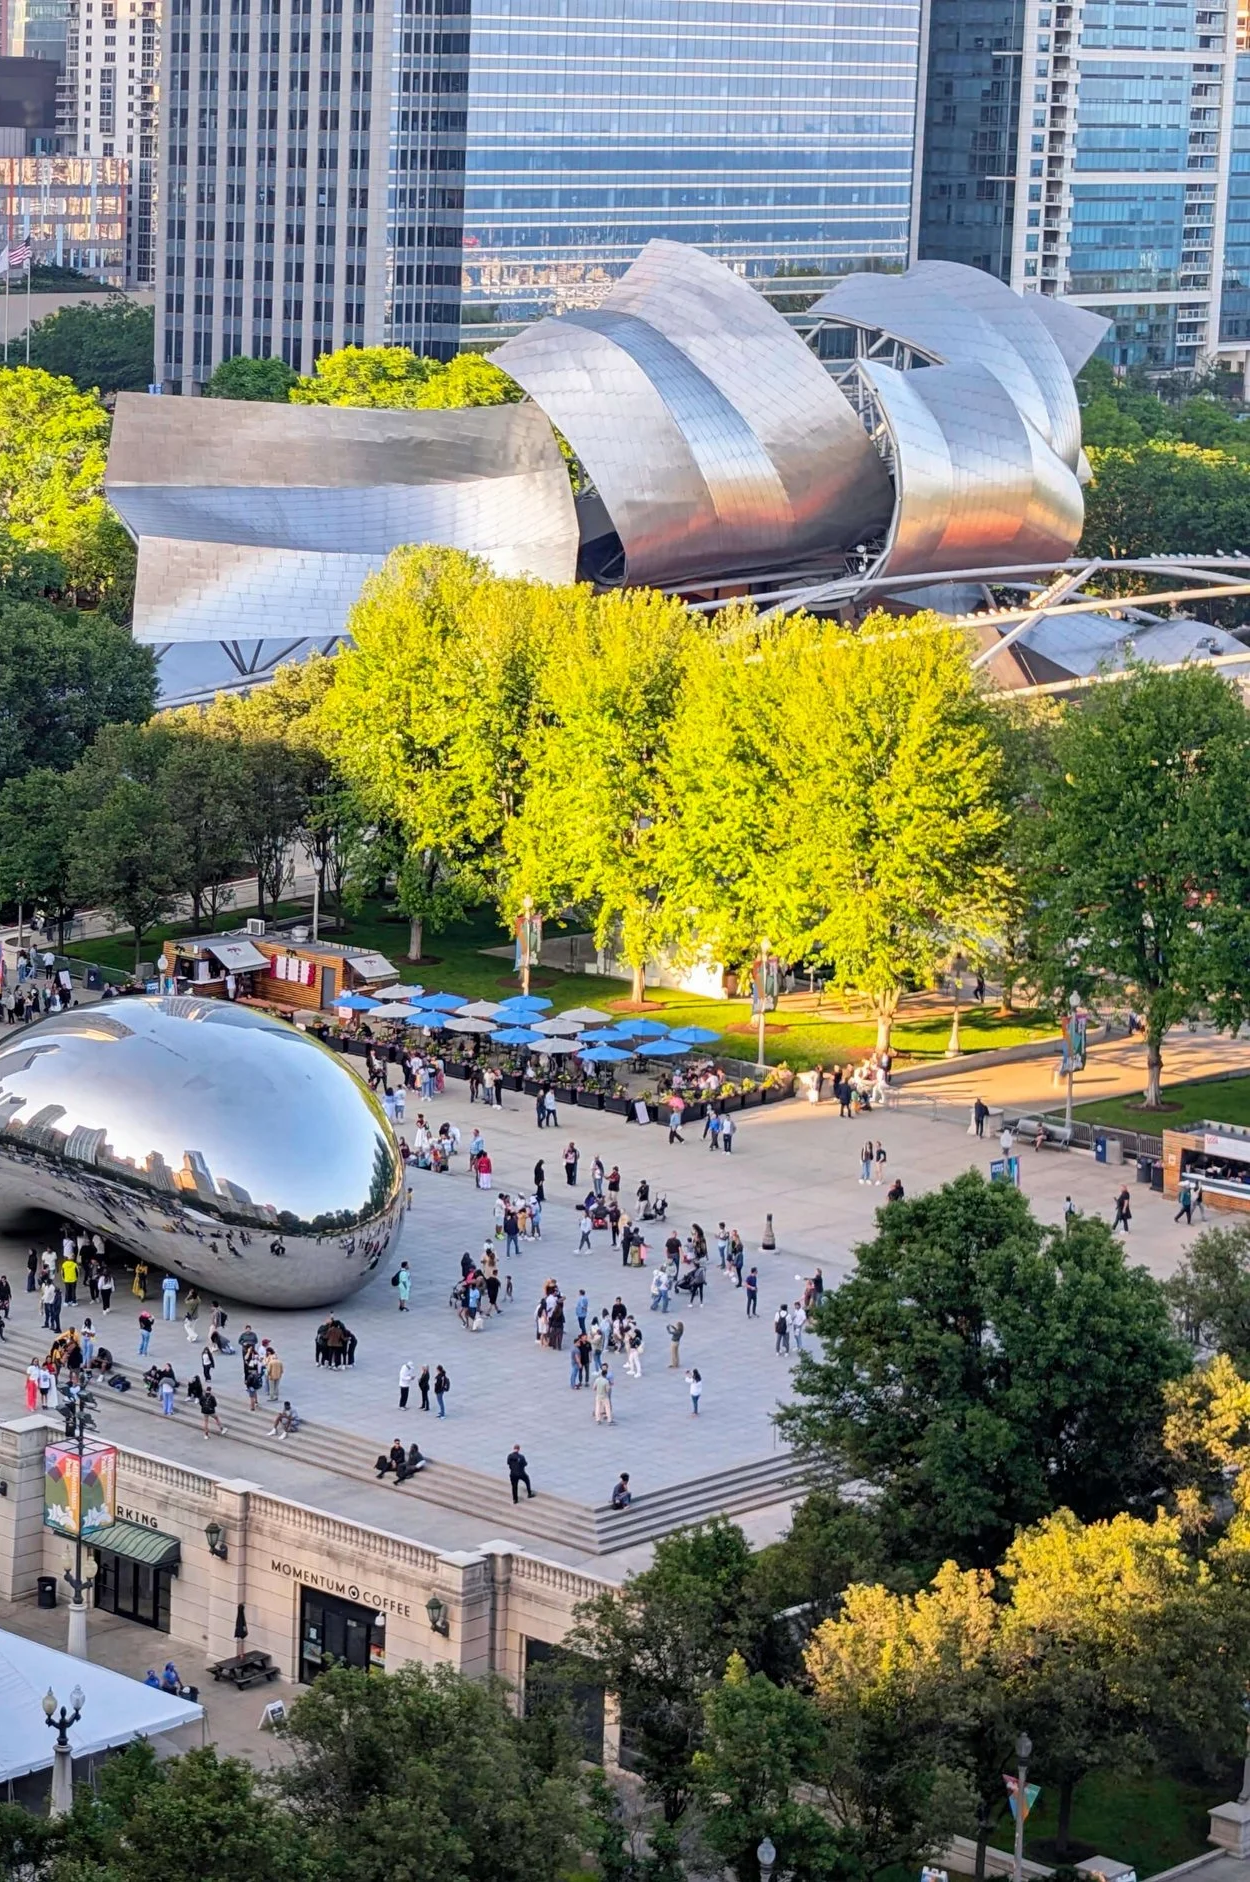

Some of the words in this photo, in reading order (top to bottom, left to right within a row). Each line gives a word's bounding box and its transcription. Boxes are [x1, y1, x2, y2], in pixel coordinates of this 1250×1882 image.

[116, 1505, 158, 1528] RKING
[271, 1559, 346, 1595] MOMENTUM
[362, 1591, 411, 1617] COFFEE
